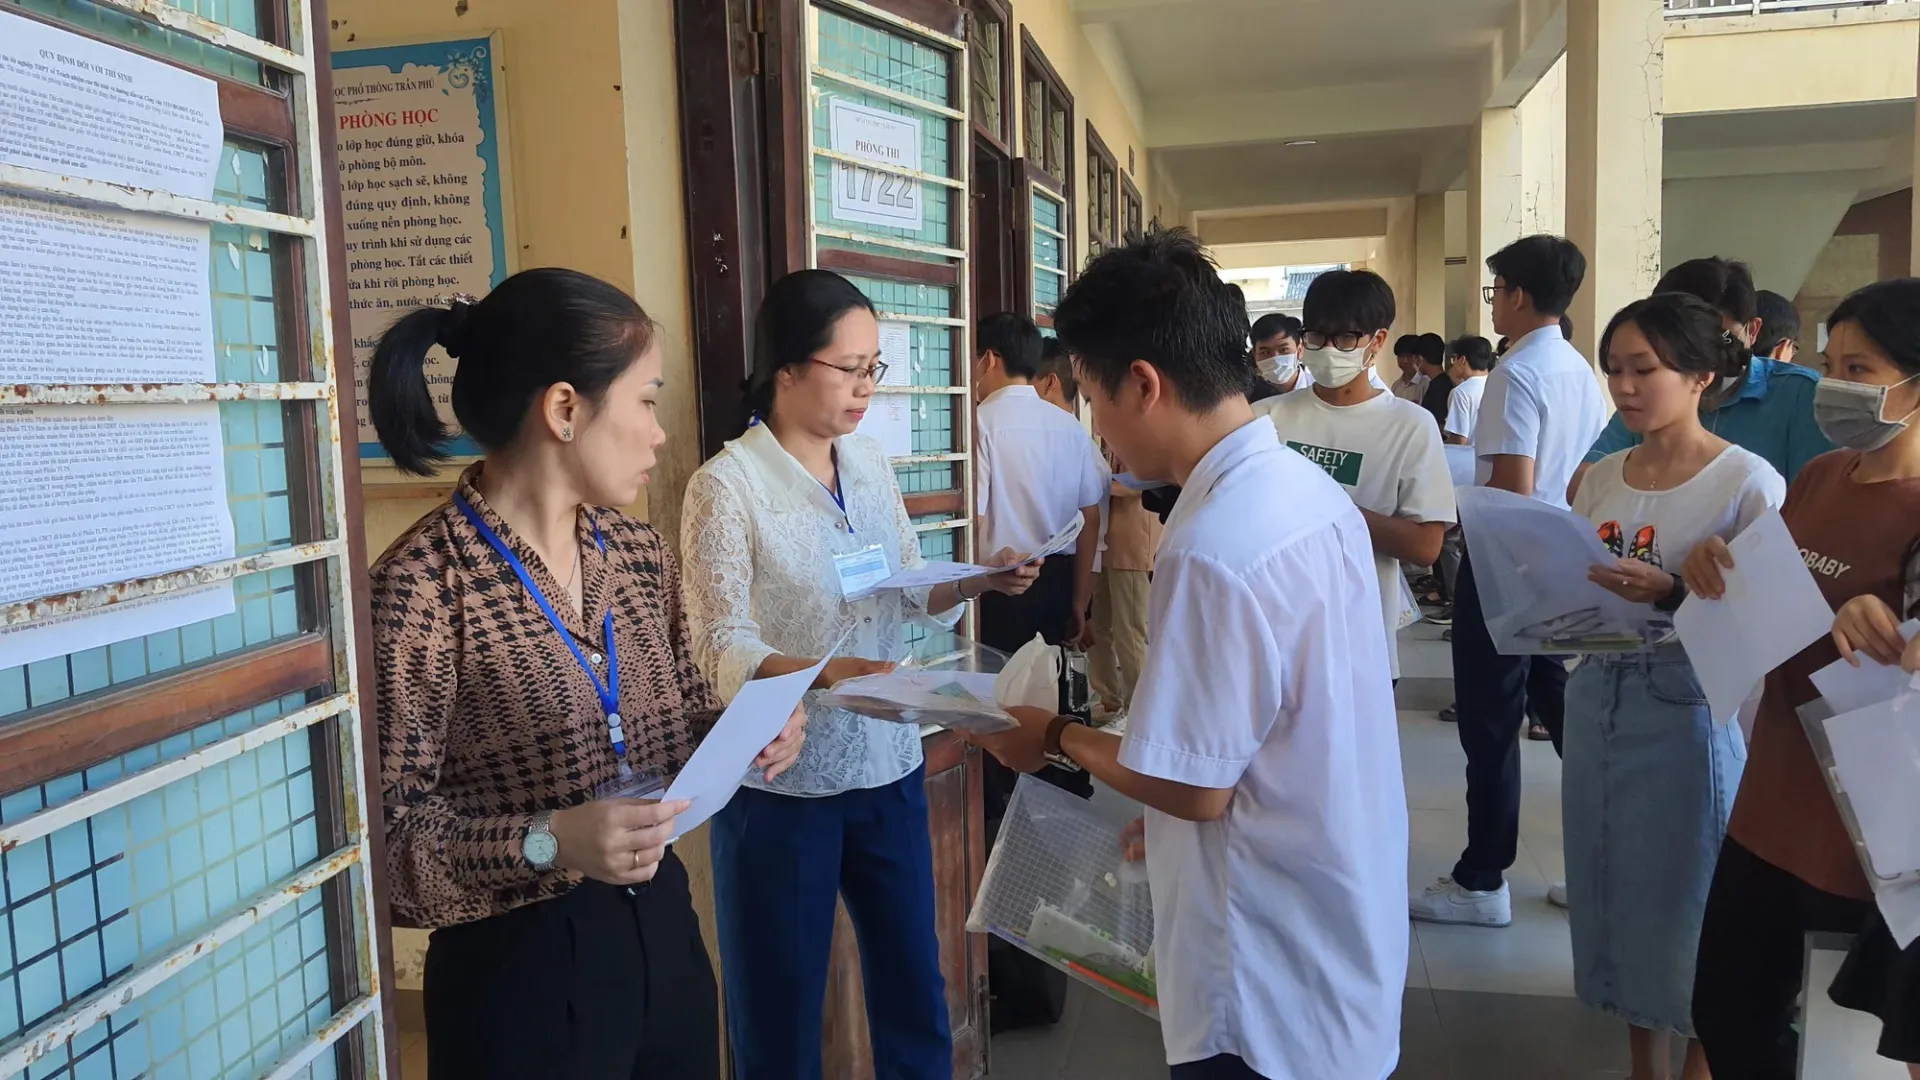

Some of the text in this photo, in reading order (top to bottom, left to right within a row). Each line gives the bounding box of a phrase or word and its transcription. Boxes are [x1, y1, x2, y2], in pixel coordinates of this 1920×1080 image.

[333, 87, 346, 98] ỌC
[366, 81, 394, 94] THÔNG
[418, 77, 435, 90] PHÚ
[339, 108, 440, 130] PHÒNG HỌC
[346, 140, 362, 152] lớp
[364, 139, 383, 151] học
[386, 136, 413, 149] đúng
[415, 134, 435, 148] giờ,
[437, 132, 465, 144] khóa
[855, 139, 900, 160] PHÒNG THI
[348, 159, 381, 173] phòng
[383, 157, 397, 170] bộ
[399, 156, 426, 167] môn.
[347, 180, 364, 192] lớp
[367, 179, 386, 191] học
[389, 176, 413, 190] sạch
[415, 175, 430, 186] sẽ,
[433, 173, 468, 186] không
[841, 161, 914, 209] 1722
[345, 194, 470, 212] đúng quy định, không
[346, 214, 462, 232] xuống nền phòng học.
[346, 233, 472, 252] uy trình khi sử dụng các
[350, 251, 473, 272] phòng học. Tắt các thiết
[348, 274, 460, 290] ửa khi rời phòng học.
[349, 298, 374, 309] thức
[376, 297, 393, 309] ăn,
[396, 296, 424, 307] nước
[423, 357, 440, 368] ọc.
[1300, 445, 1349, 466] SAFETY
